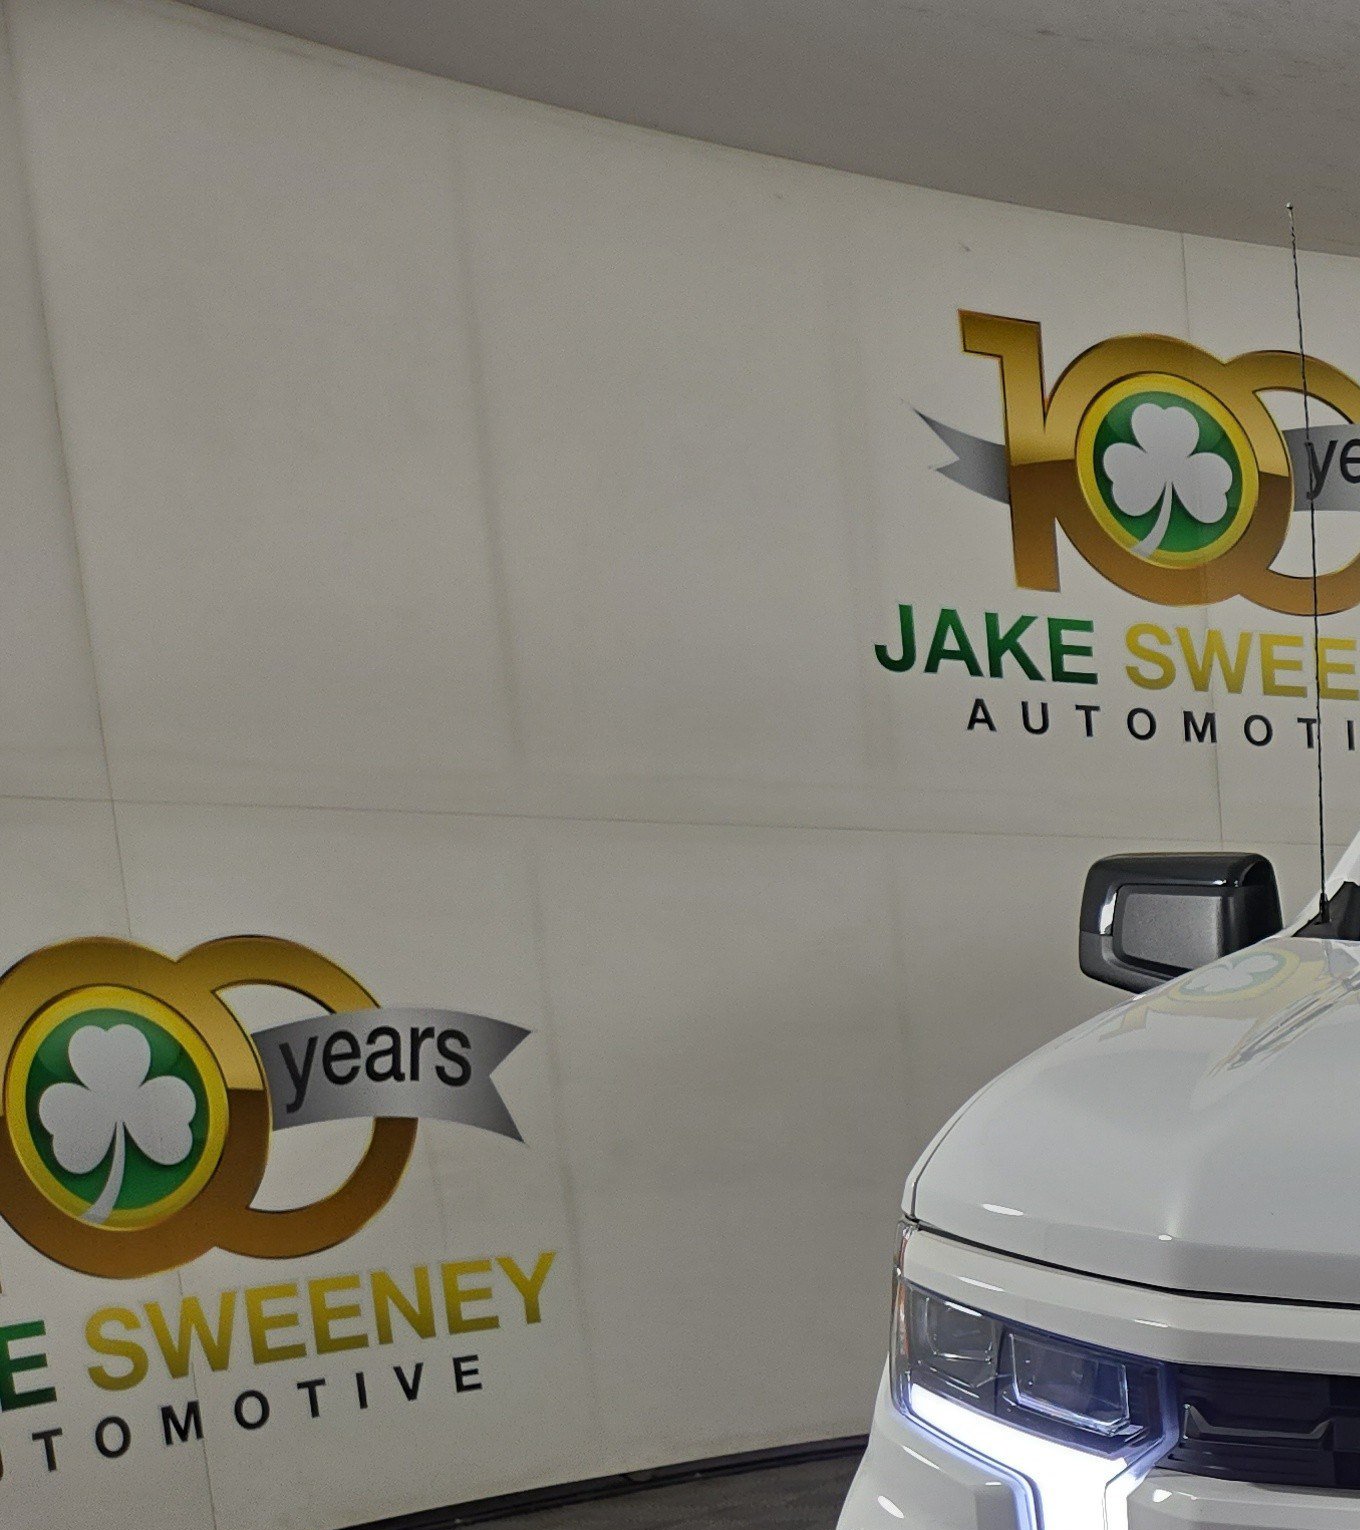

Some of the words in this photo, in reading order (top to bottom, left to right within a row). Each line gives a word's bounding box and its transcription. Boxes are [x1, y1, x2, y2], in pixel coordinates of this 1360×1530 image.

[874, 603, 1099, 685] JAKE
[279, 1024, 472, 1113] years
[85, 1250, 557, 1391] SWEENEY
[0, 1354, 483, 1482] TOMOTIVE
